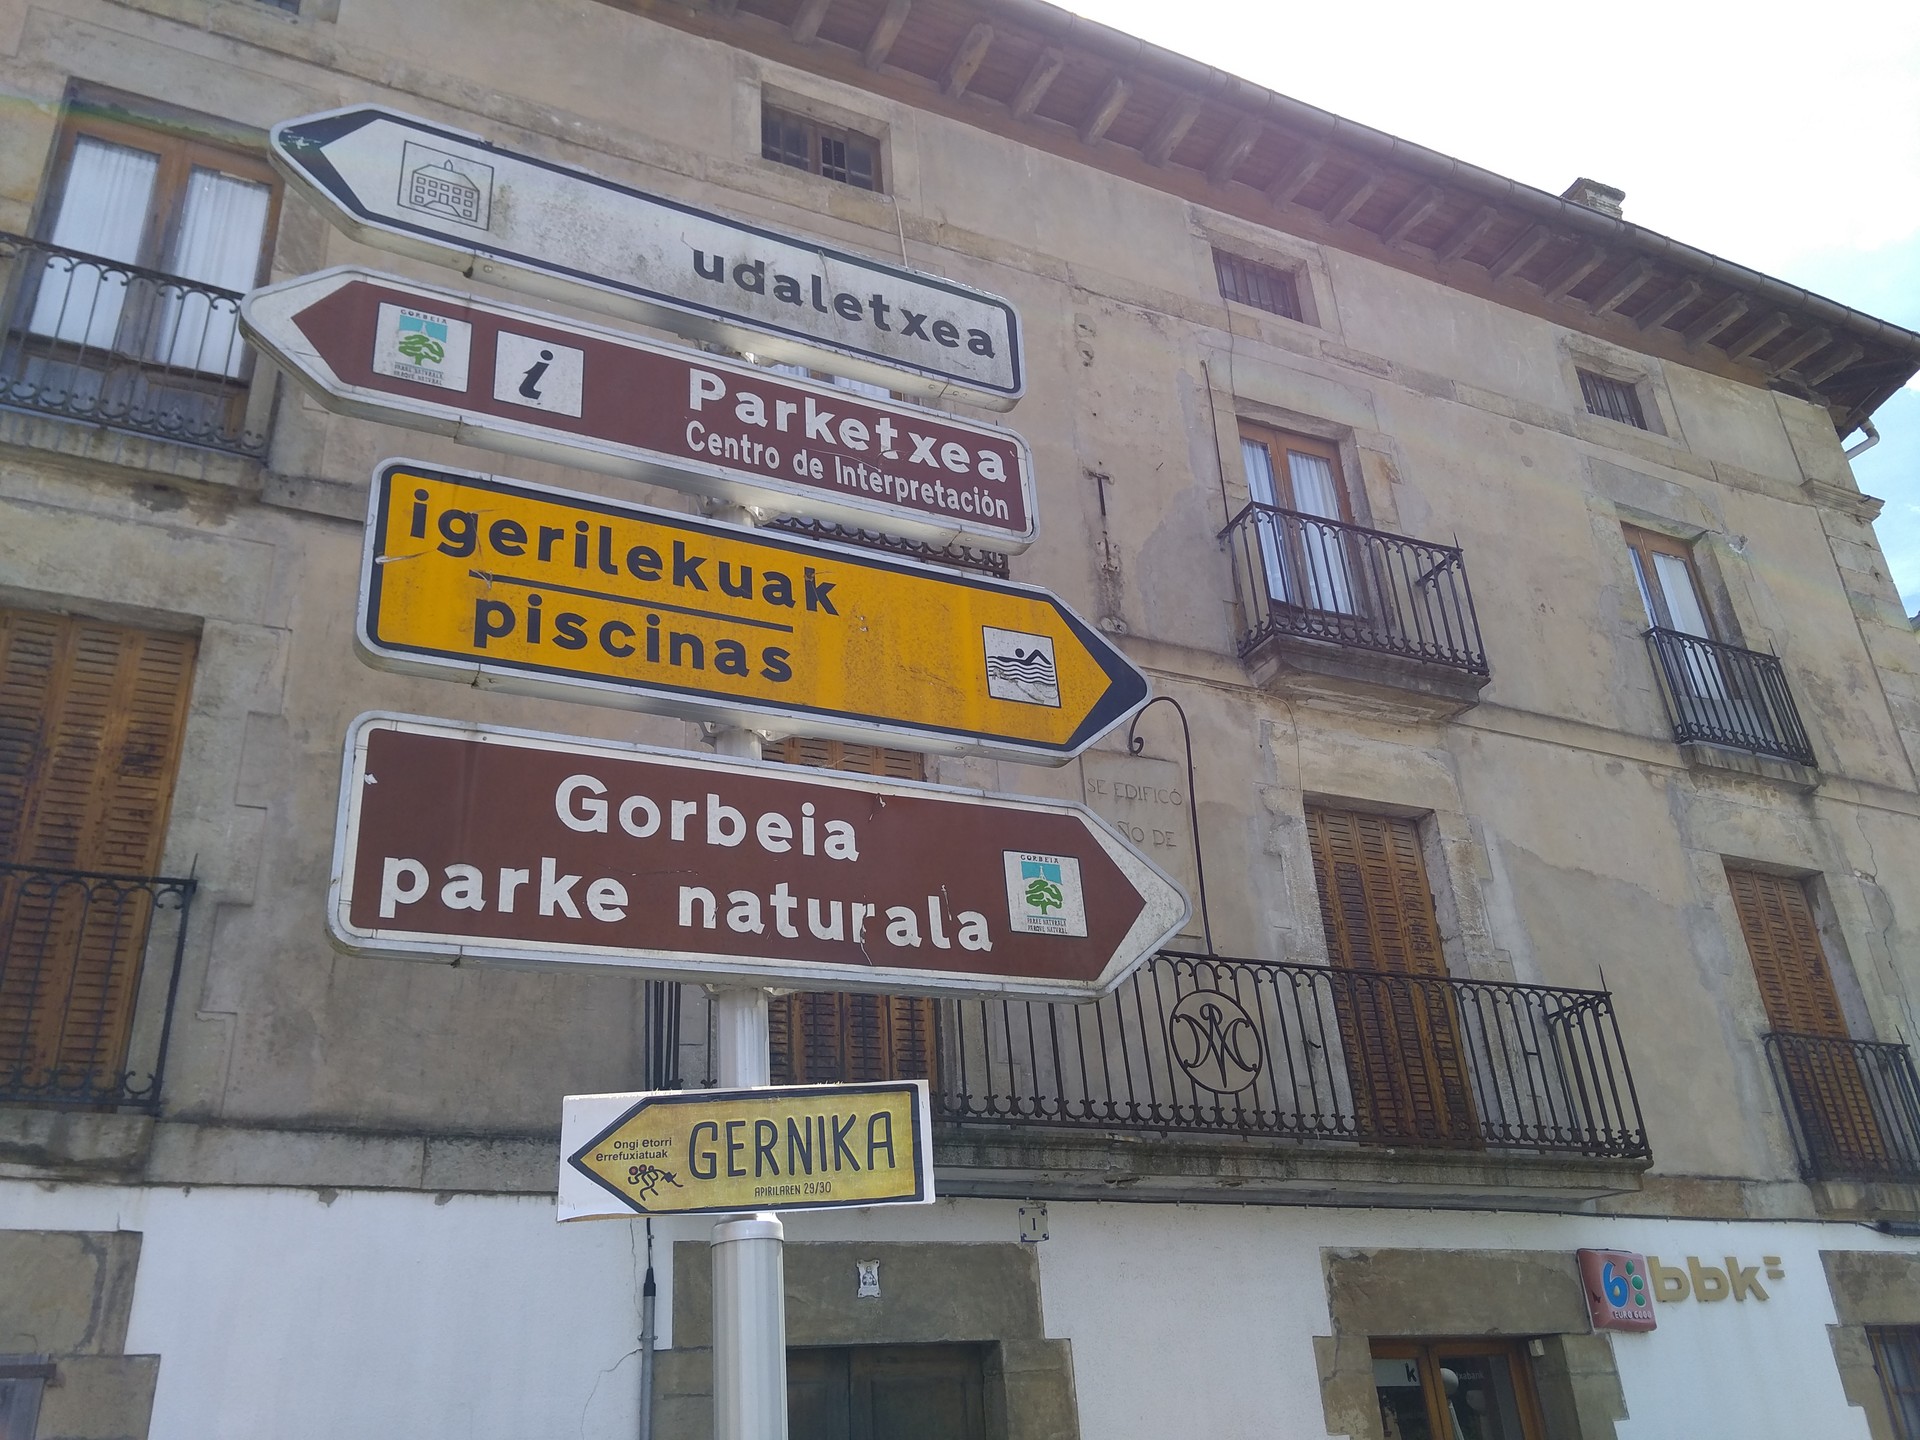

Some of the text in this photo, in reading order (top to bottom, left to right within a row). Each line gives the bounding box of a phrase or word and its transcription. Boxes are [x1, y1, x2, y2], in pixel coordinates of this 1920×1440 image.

[400, 309, 448, 324] GORBEIA
[693, 249, 996, 359] udaletxea
[689, 368, 1008, 483] Parketxea
[686, 420, 1010, 521] Centro de Interpretación
[409, 488, 839, 617] igerilekuak
[473, 593, 794, 684] piscinas
[1087, 778, 1107, 795] SE
[555, 774, 859, 862] Gorbeia
[1116, 820, 1177, 848] ÑO DE
[1020, 854, 1059, 864] GORBEIA
[379, 857, 994, 952] parke naturala
[613, 1139, 639, 1151] Ongi
[689, 1111, 896, 1180] GERNIKA
[754, 1181, 832, 1198] APIRILAREN 29/30
[1646, 1256, 1770, 1302] bbk
[1613, 1310, 1652, 1320] EURO 6000
[1405, 1362, 1417, 1383] k
